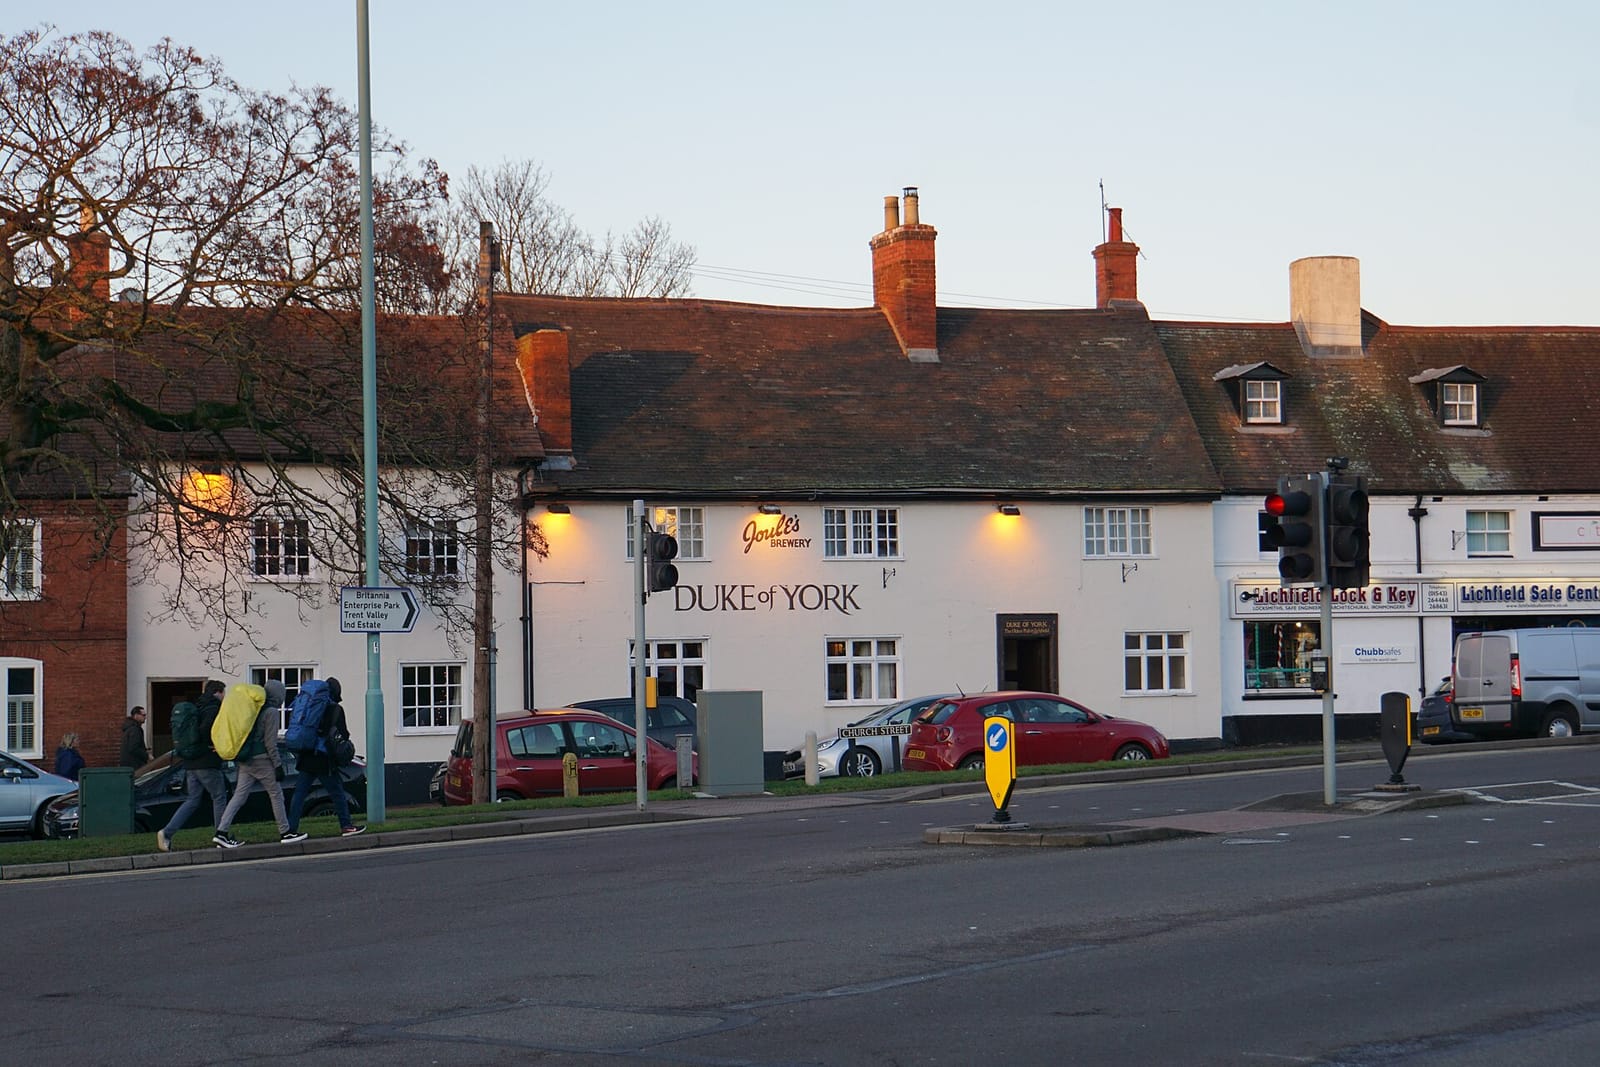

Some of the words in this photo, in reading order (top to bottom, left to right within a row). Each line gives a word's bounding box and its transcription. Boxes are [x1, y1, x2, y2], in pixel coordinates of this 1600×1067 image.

[770, 538, 812, 548] BREWERY
[356, 591, 390, 599] Britannia
[1331, 587, 1367, 603] Lock
[1373, 587, 1382, 603] &
[1389, 586, 1416, 607] Key
[1461, 585, 1525, 602] Lichfield
[1530, 585, 1562, 601] Safe
[1567, 585, 1600, 601] Cent
[675, 584, 756, 612] DUKE
[758, 585, 777, 612] of
[779, 584, 861, 616] YORK
[343, 601, 382, 611] Enterprise
[383, 601, 400, 609] Park
[344, 611, 364, 619] Trent
[366, 611, 389, 620] Valley
[344, 621, 356, 629] Ind
[357, 621, 382, 629] Estate
[1354, 646, 1402, 656] Chubbsafes
[842, 727, 878, 737] CHURCH
[880, 725, 909, 735] STREET
